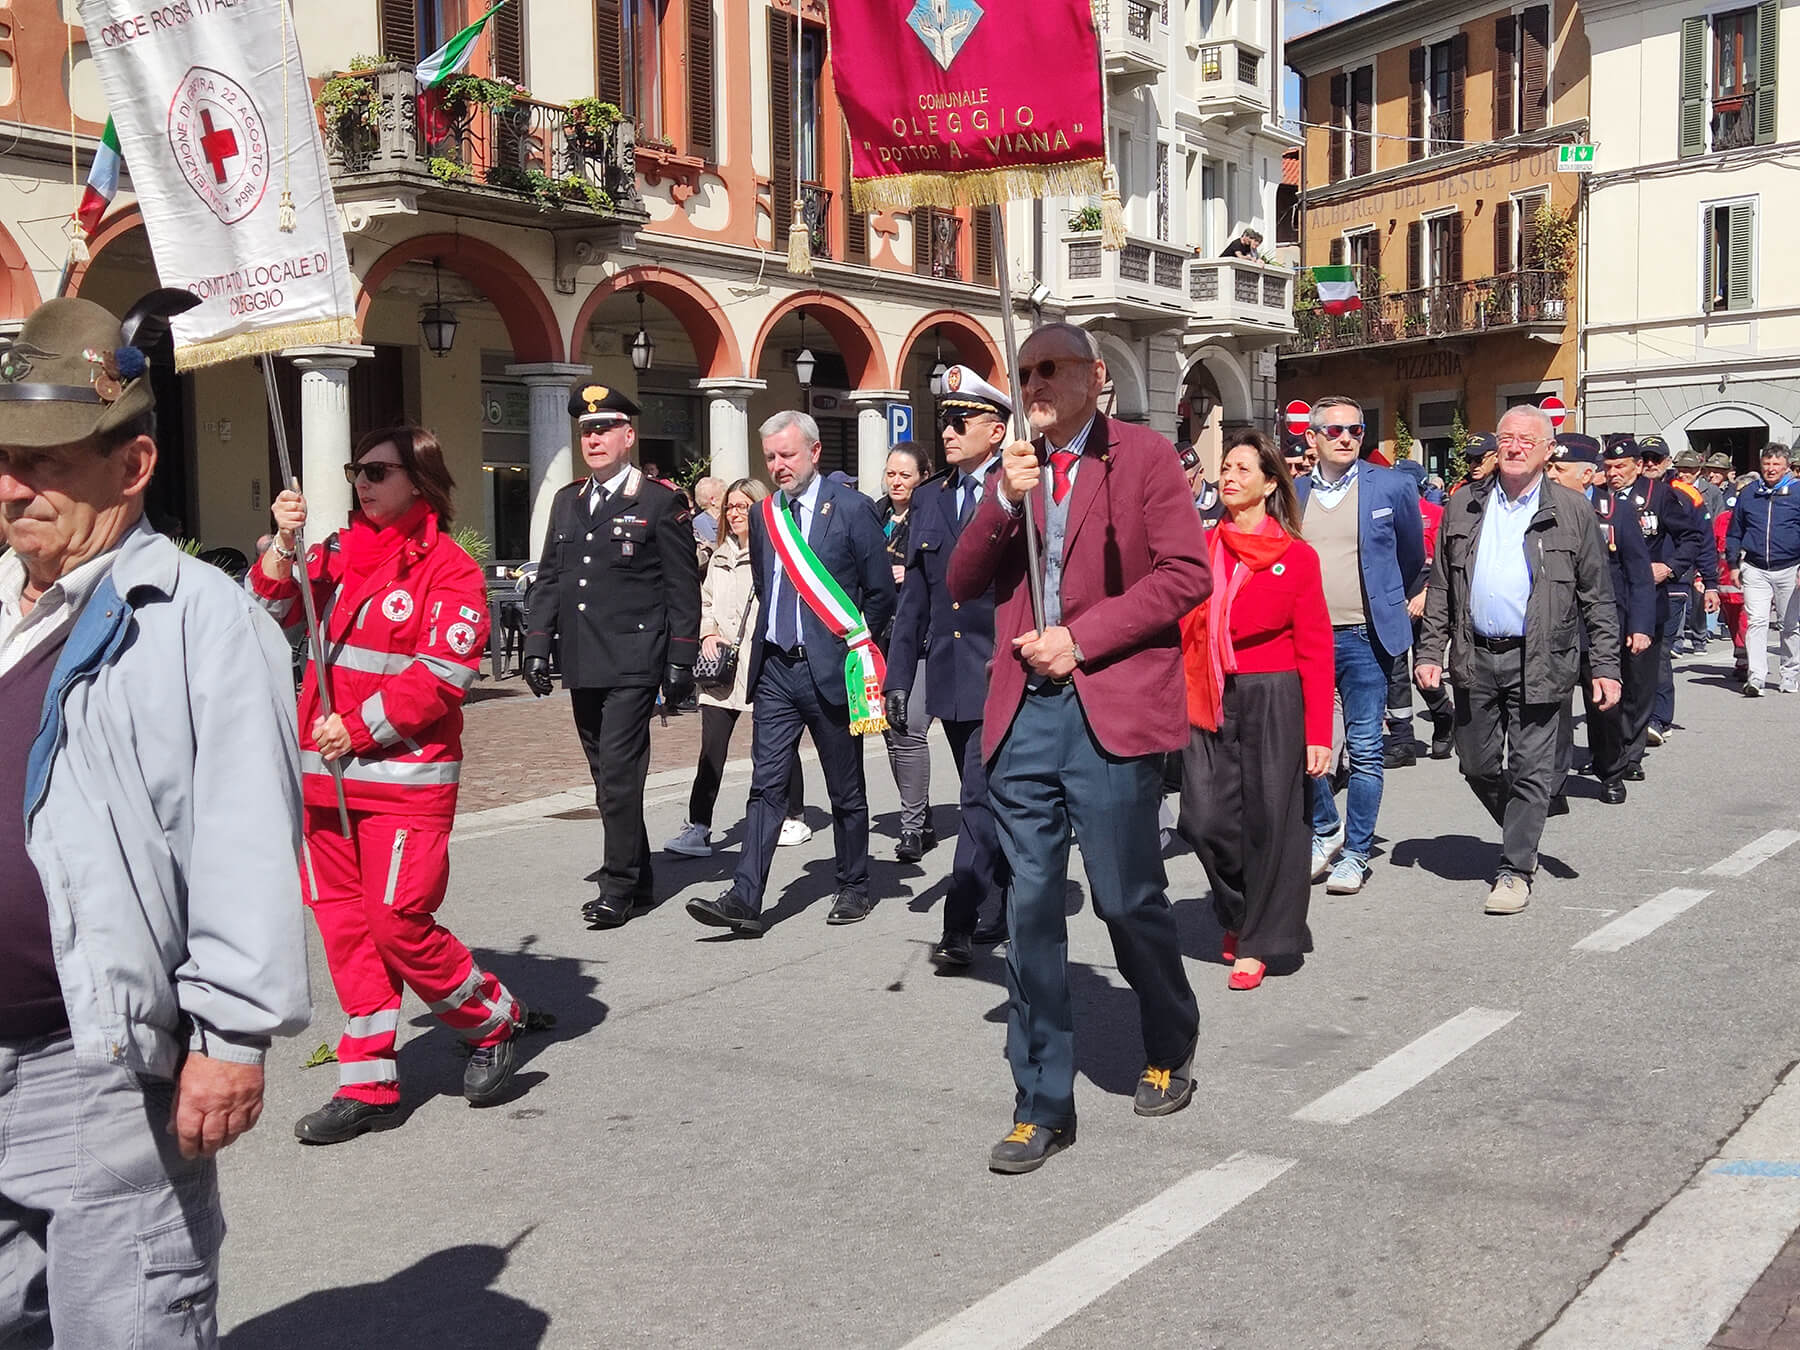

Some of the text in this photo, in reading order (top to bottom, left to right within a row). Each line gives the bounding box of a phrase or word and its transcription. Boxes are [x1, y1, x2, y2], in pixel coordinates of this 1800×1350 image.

[221, 87, 237, 105] 22
[919, 88, 989, 110] COMUNALE
[892, 106, 1034, 137] OLEGGIO
[238, 106, 262, 177] AGOSTO
[950, 138, 968, 160] A.
[235, 182, 256, 208] 1864
[1312, 193, 1385, 229] ALBERGO
[1394, 184, 1427, 210] DEL
[1436, 168, 1497, 199] PESCE
[245, 257, 312, 288] LOCALE
[314, 252, 327, 273] DI
[1395, 350, 1463, 379] PIZZERIA
[893, 408, 908, 445] P
